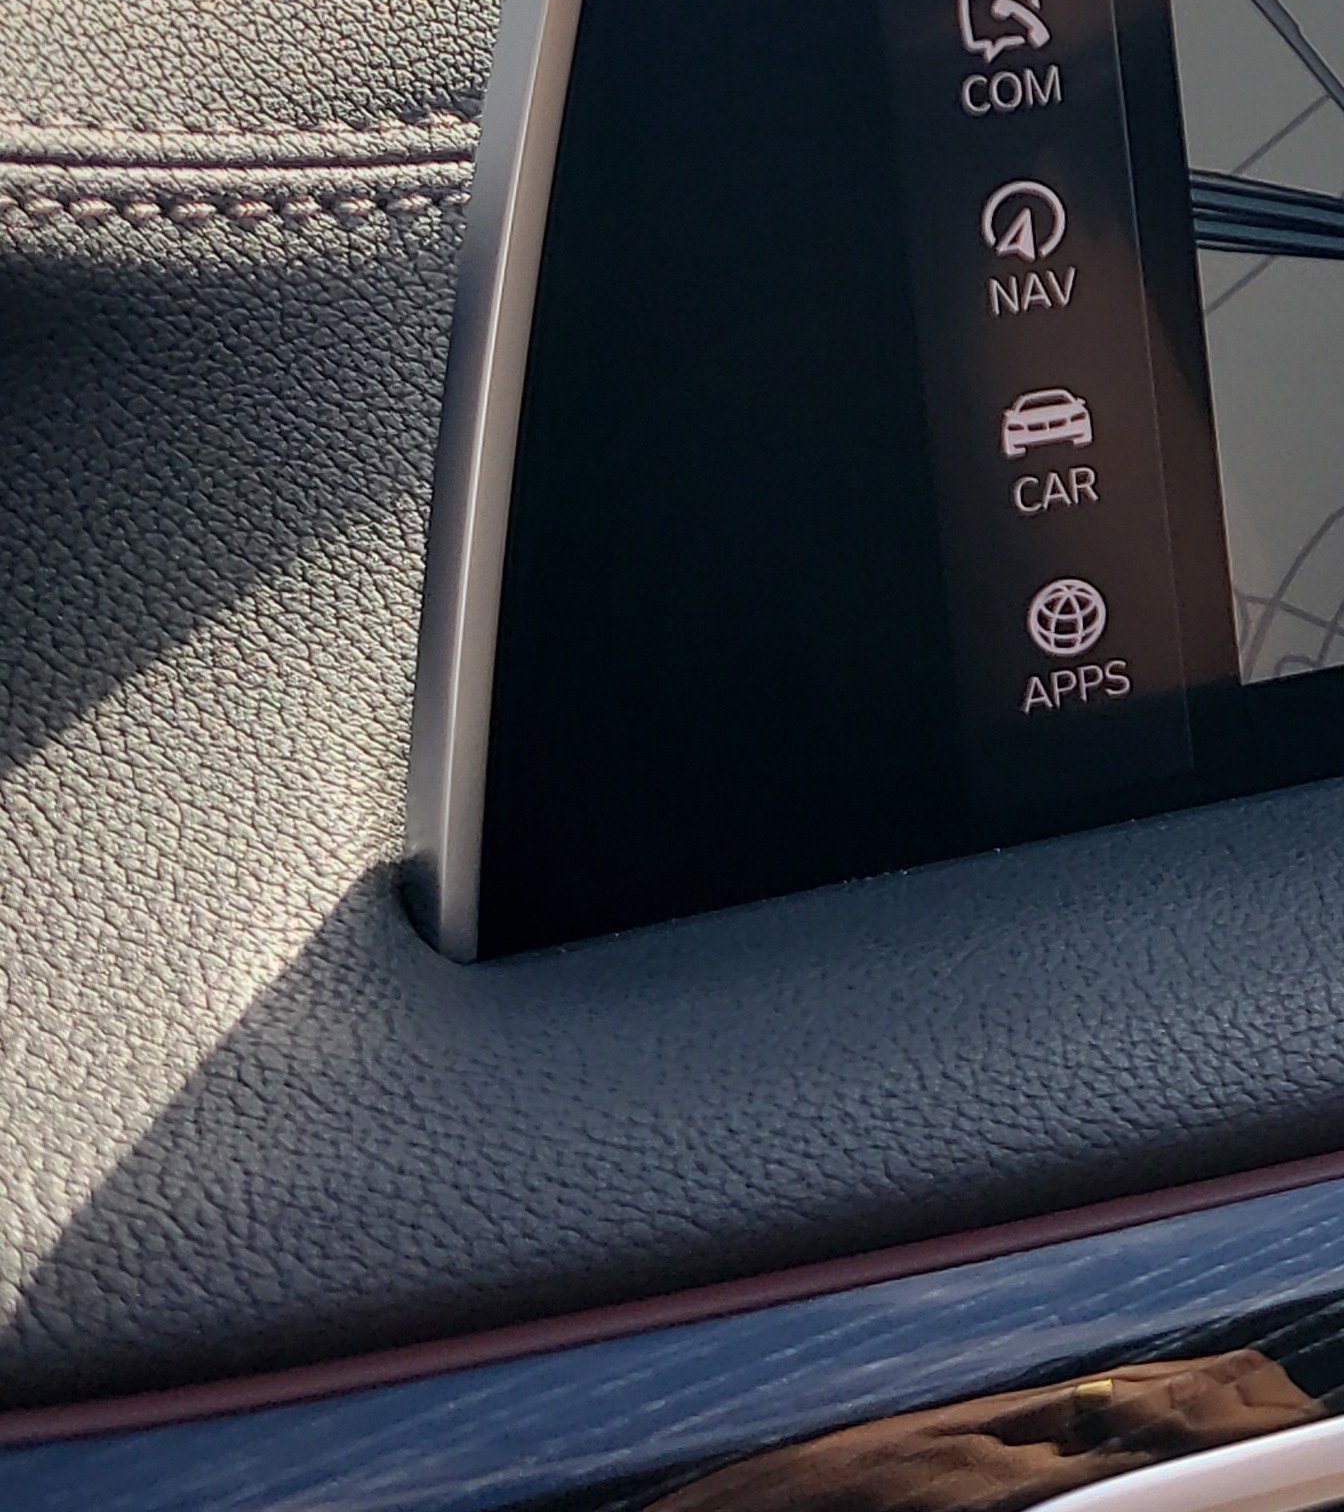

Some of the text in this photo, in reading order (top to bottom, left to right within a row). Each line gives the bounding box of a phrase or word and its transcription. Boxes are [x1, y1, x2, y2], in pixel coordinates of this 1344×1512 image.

[960, 64, 1062, 116] COM
[987, 267, 1076, 316] NAV
[1013, 467, 1099, 511] CAR
[1024, 661, 1131, 713] APPS
